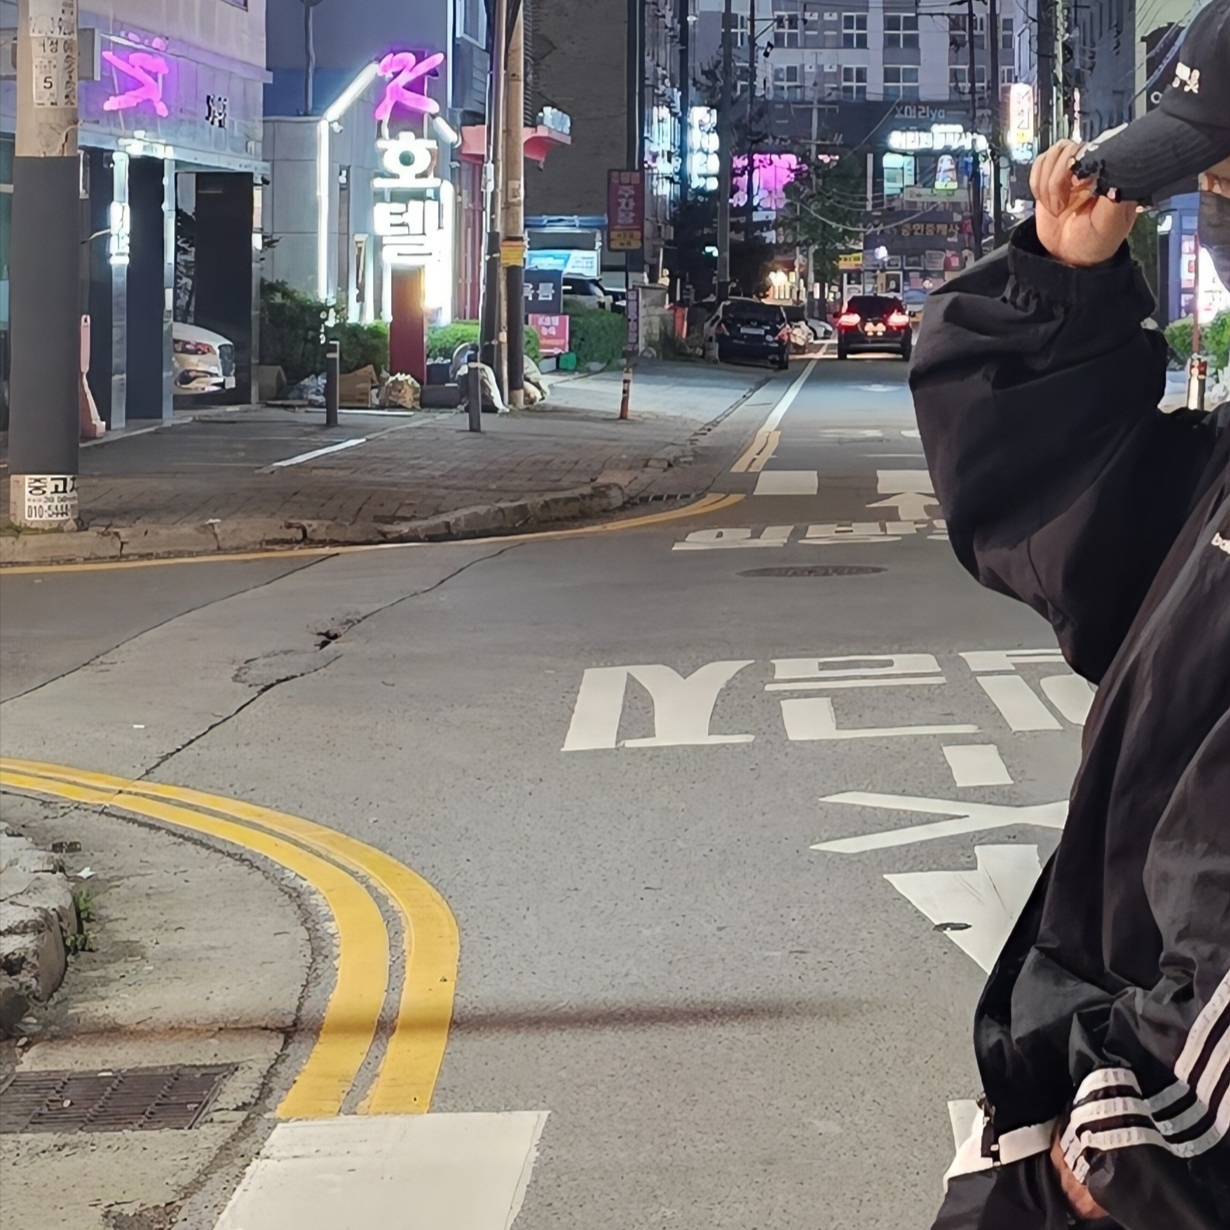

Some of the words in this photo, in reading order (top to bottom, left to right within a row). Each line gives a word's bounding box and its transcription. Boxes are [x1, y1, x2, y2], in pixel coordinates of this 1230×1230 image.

[43, 76, 54, 90] 5
[374, 52, 445, 120] K
[672, 519, 949, 551] 일방
